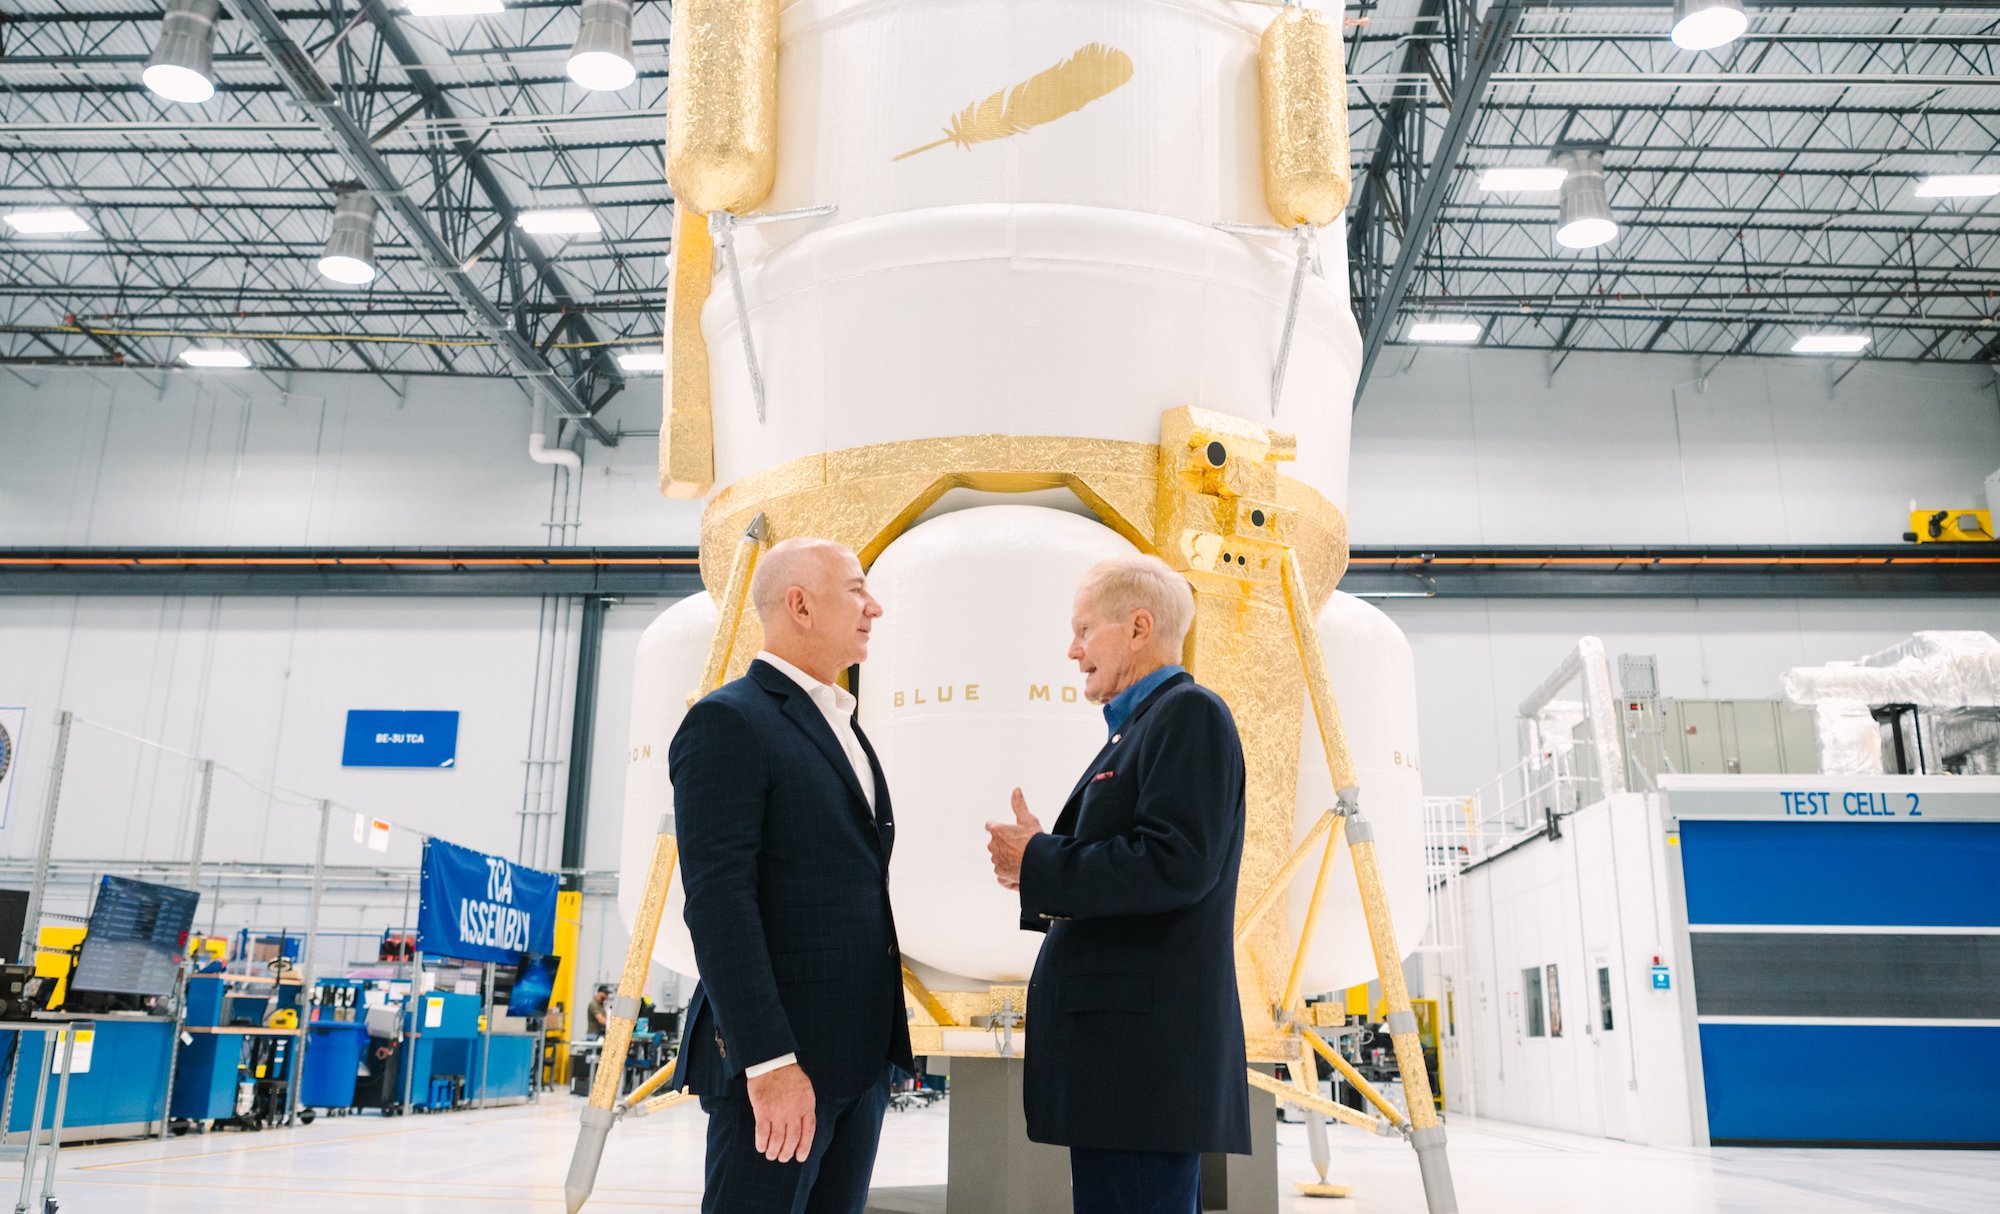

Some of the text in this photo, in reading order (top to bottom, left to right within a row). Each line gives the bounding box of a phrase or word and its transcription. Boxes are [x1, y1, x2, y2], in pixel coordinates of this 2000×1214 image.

[893, 684, 980, 708] BLUE
[406, 734, 425, 744] TCA
[1780, 791, 1922, 816] TEST CELL 2
[485, 857, 513, 905] TCA
[459, 897, 531, 952] ASSEMBLY
